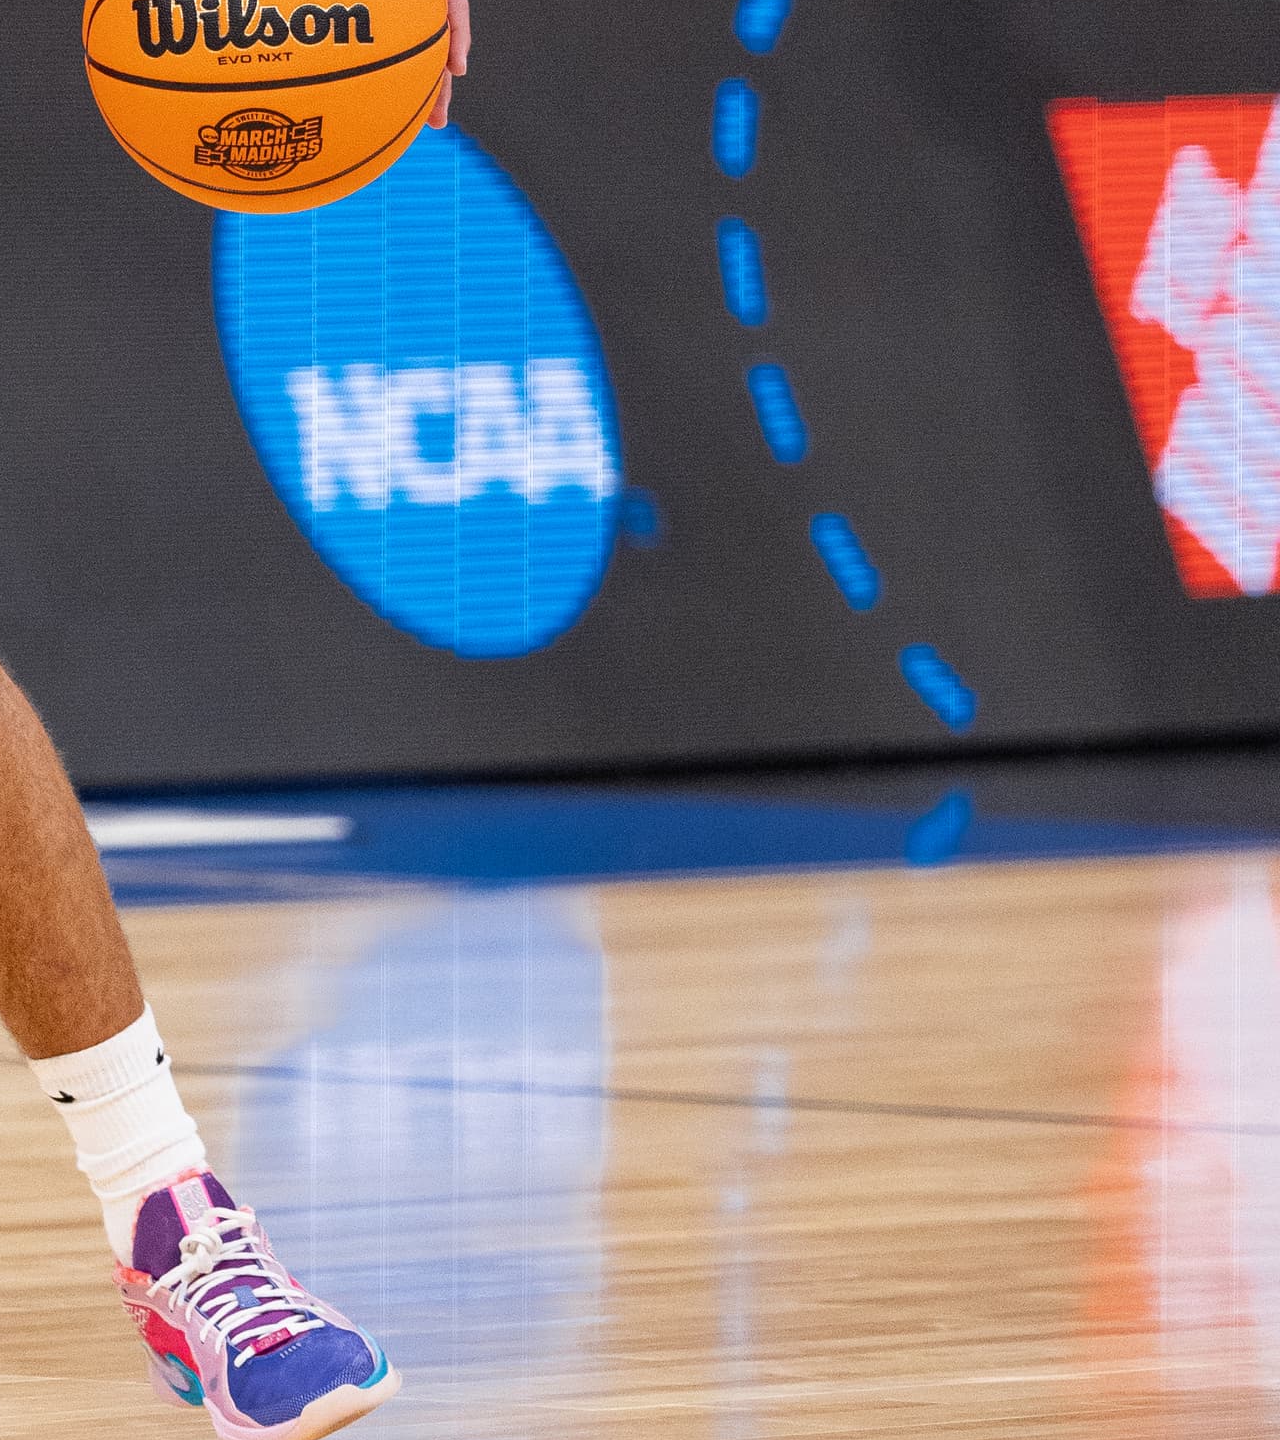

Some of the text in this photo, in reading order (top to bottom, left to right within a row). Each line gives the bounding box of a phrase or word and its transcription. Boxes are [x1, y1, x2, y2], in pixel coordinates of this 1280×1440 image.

[217, 52, 294, 66] EVO NXT
[219, 126, 288, 147] MARCH
[229, 138, 322, 163] MADNESS
[284, 357, 620, 512] NCAA
